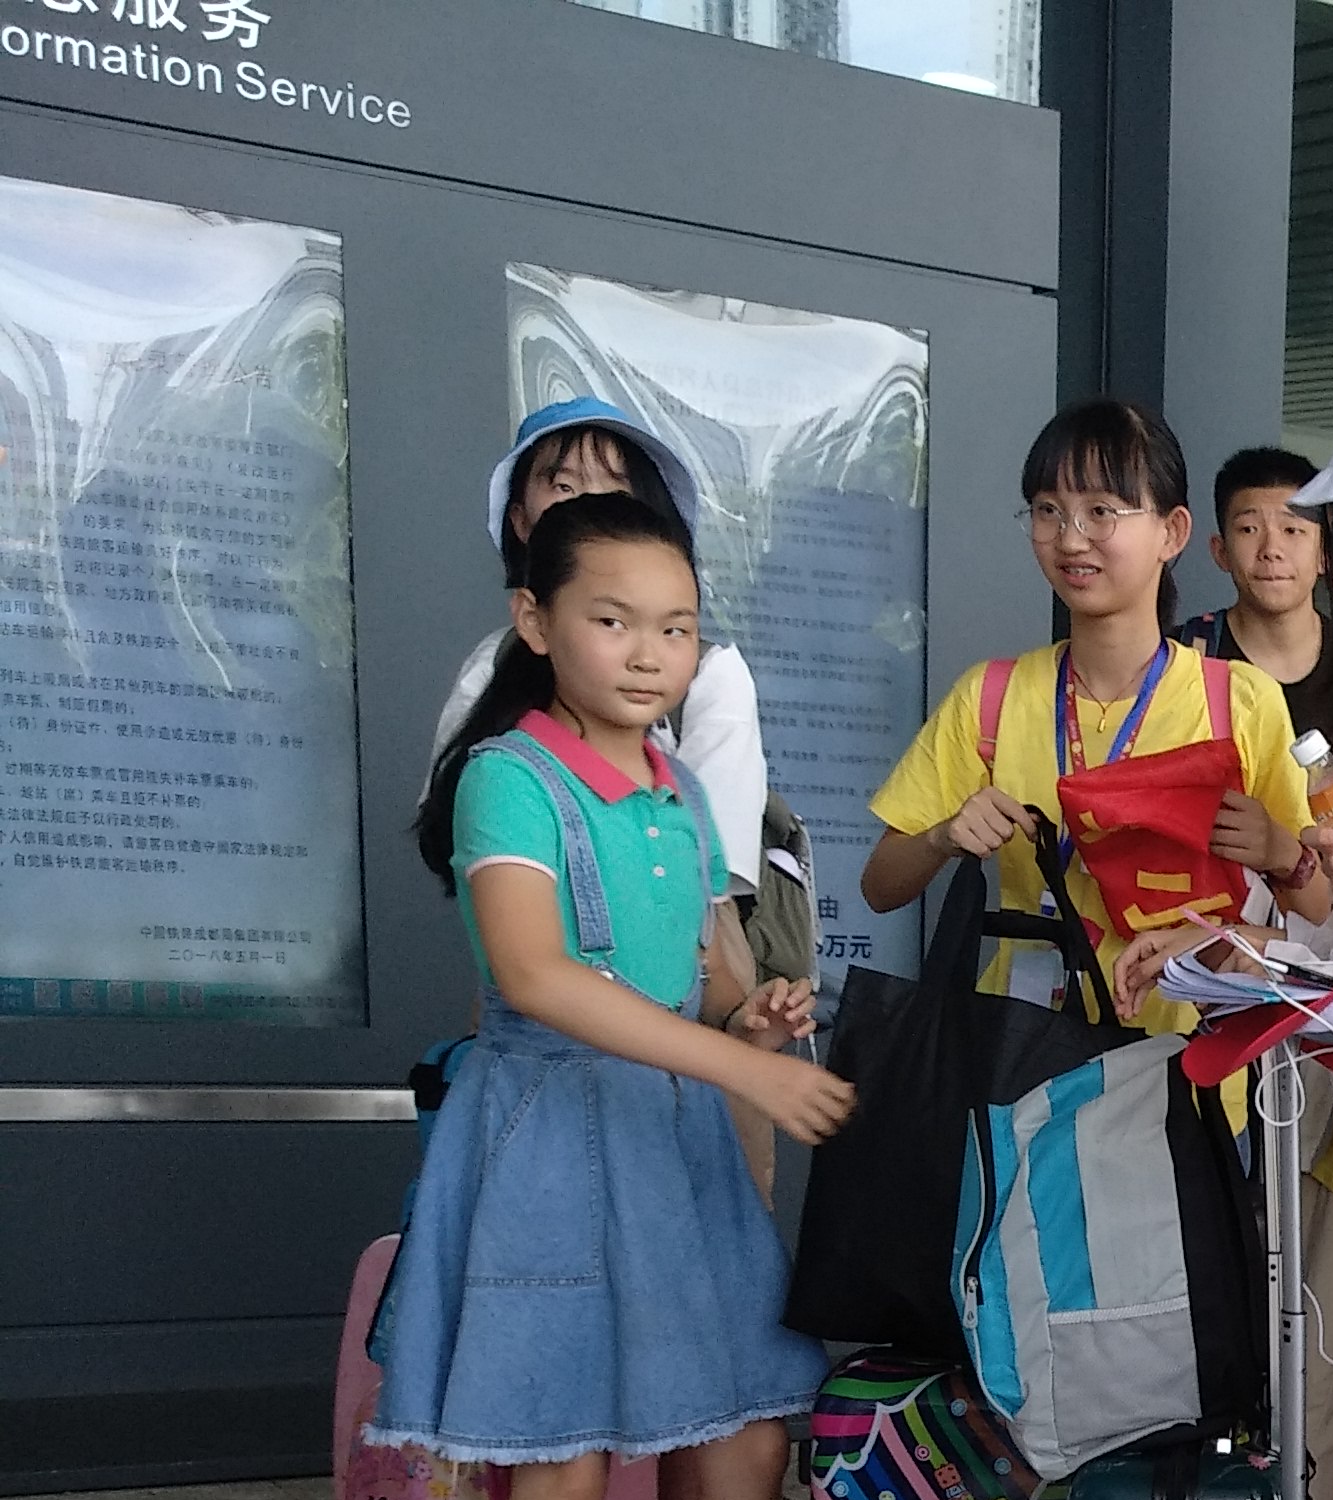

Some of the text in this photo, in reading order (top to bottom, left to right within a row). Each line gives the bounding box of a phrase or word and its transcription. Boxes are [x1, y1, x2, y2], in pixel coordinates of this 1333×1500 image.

[26, 0, 271, 49] 服务
[235, 61, 412, 128] Service
[817, 934, 872, 960] 万元
